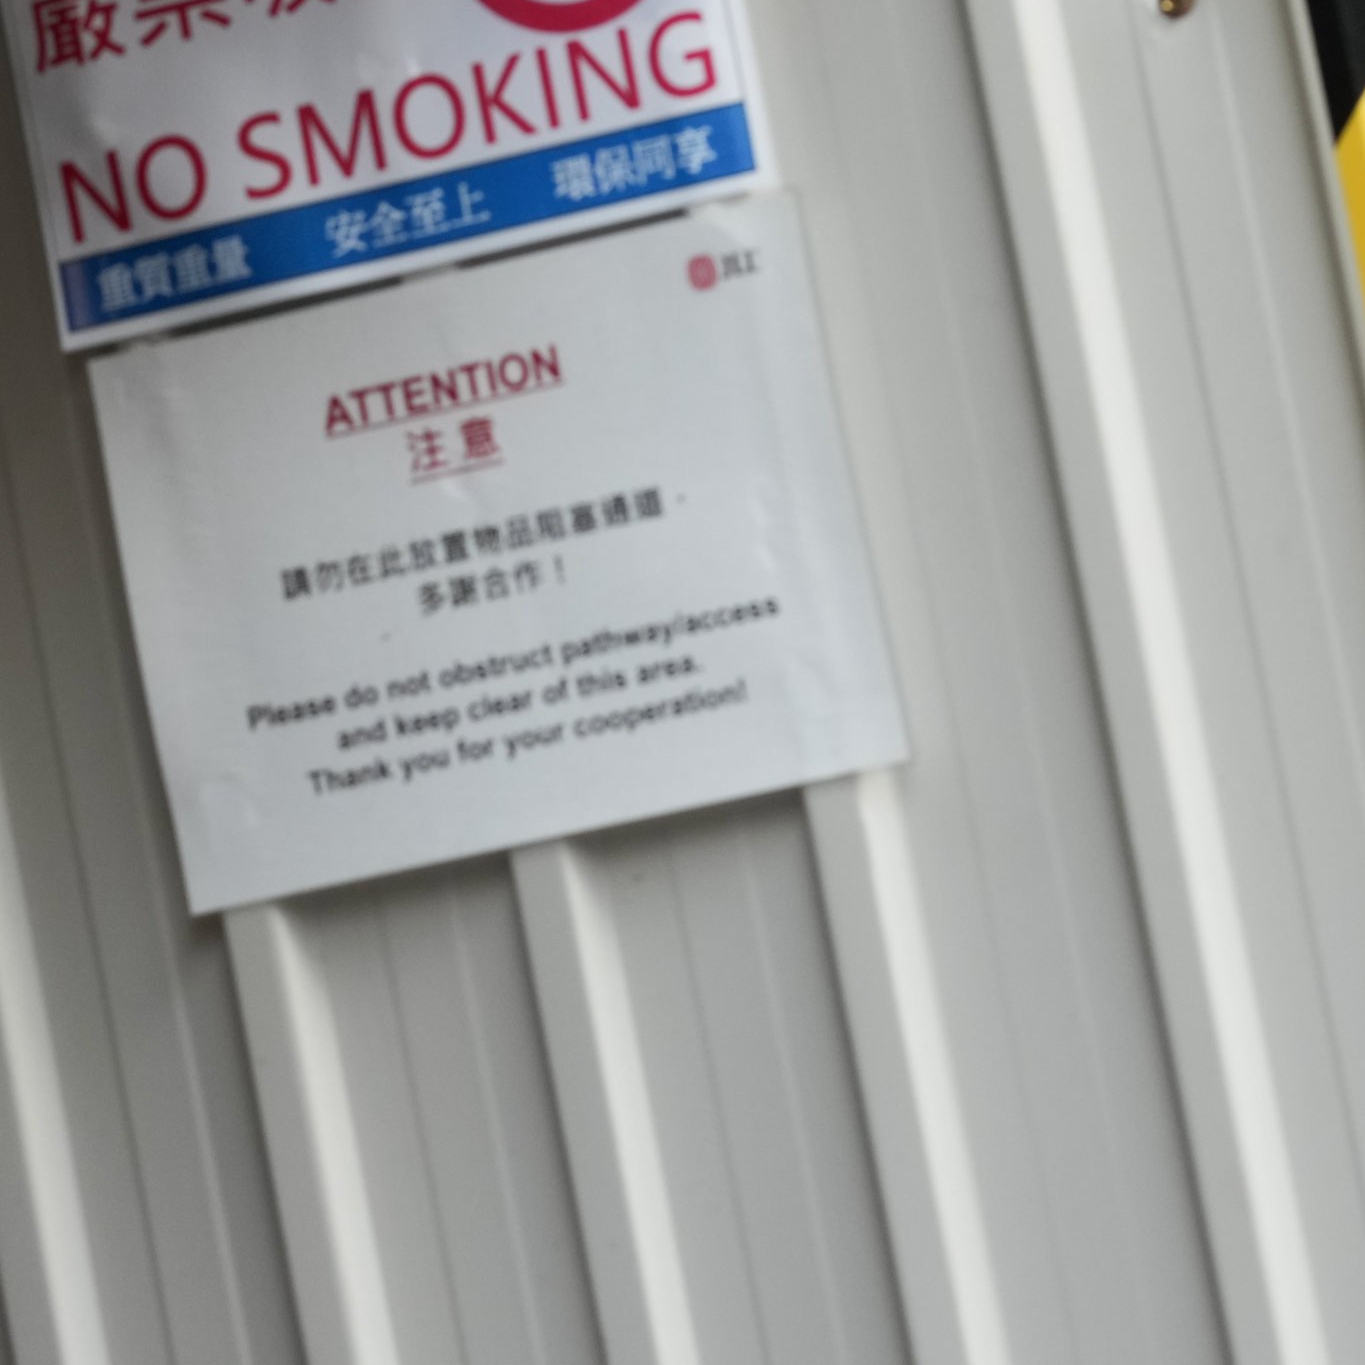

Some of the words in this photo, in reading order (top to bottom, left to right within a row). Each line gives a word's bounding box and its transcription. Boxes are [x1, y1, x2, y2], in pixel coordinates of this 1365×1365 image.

[55, 134, 207, 246] NO
[234, 11, 716, 202] SMOKING
[97, 235, 252, 312] 重質重量
[325, 181, 491, 258] 安全至上
[552, 125, 718, 201] 環保同享
[324, 347, 561, 435] ATTENTION
[407, 416, 498, 472] 注意
[245, 696, 337, 730] Please
[343, 684, 380, 711] do
[385, 670, 432, 700] not
[437, 644, 554, 690] obstruct
[559, 598, 779, 668] pathway/access
[337, 719, 388, 751] and
[393, 708, 461, 737] keep
[466, 690, 532, 722] clear
[541, 676, 569, 706] of
[575, 671, 628, 698] this
[636, 656, 703, 685] area.
[307, 759, 393, 794] Thank
[398, 750, 451, 783] you
[455, 738, 495, 762] for
[501, 722, 565, 760] your
[572, 679, 747, 739] cooperation!
